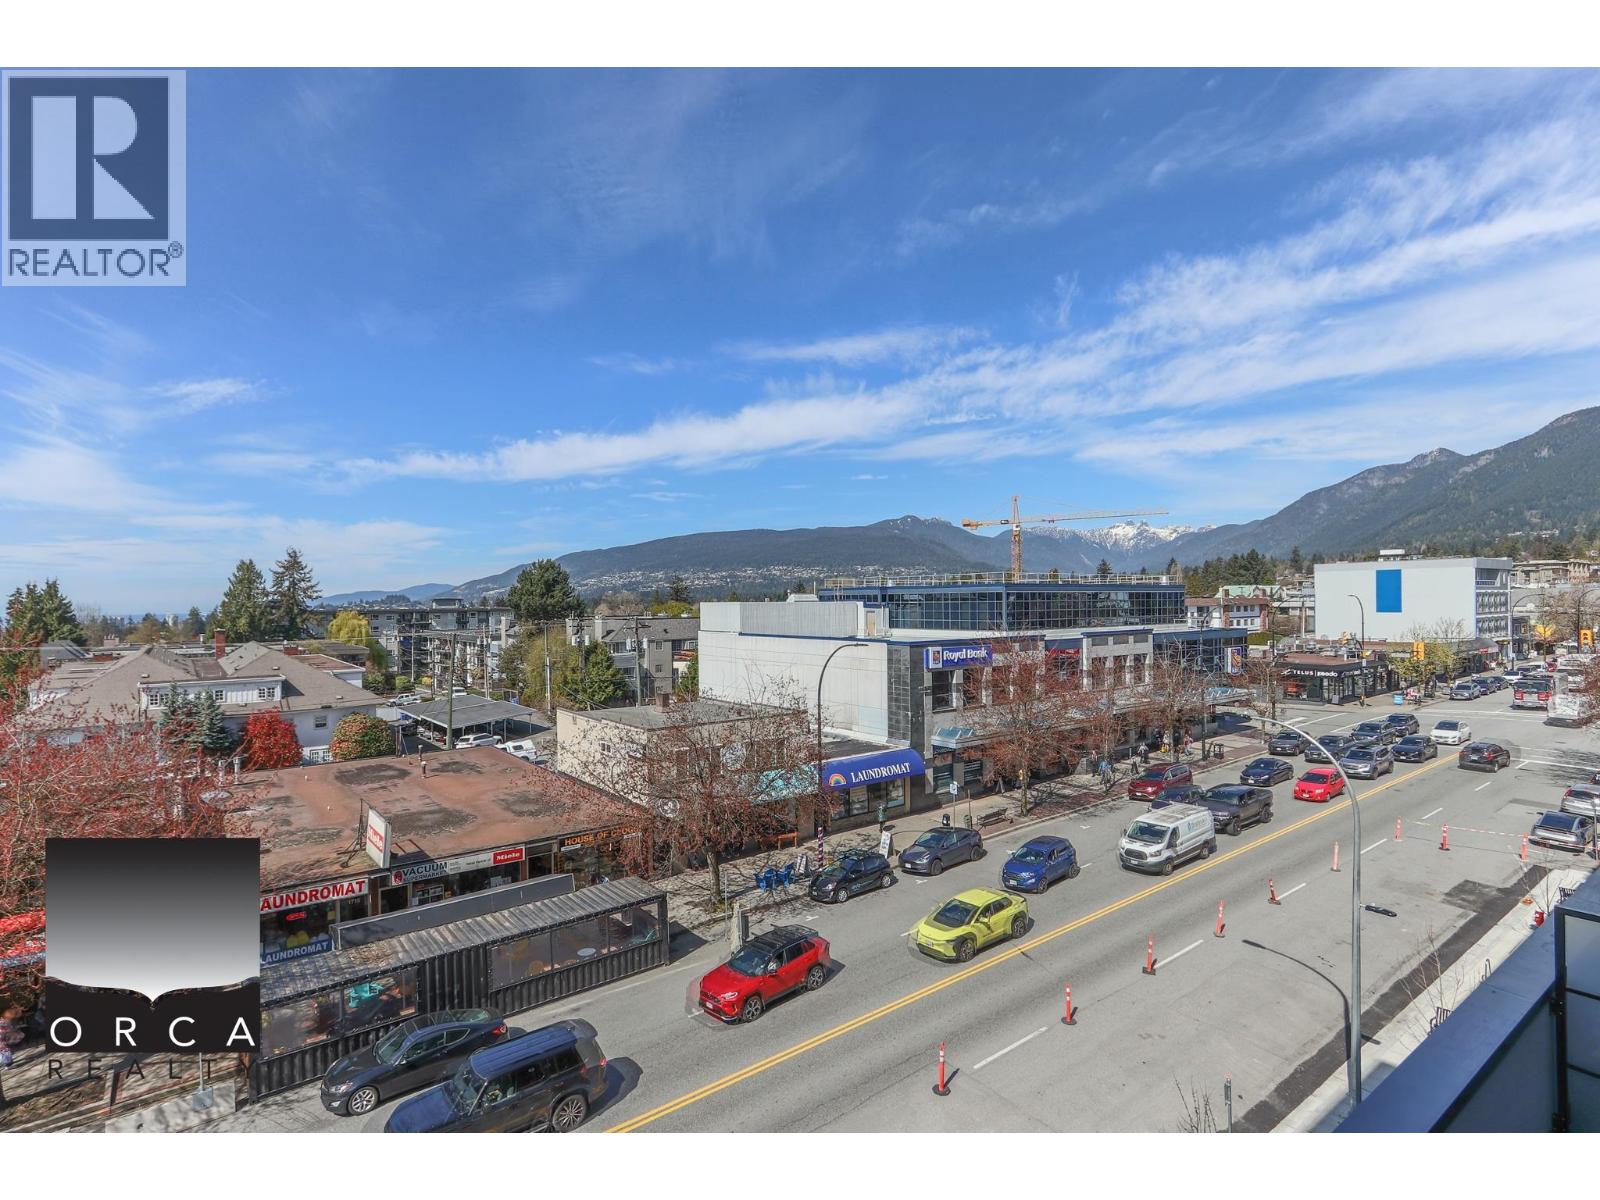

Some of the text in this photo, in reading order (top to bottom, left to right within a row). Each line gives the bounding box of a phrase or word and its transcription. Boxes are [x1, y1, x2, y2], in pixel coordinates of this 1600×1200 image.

[943, 648, 966, 663] Royal
[850, 762, 911, 783] LAUNDROMAT
[564, 834, 594, 845] HOUSE
[598, 831, 609, 839] OF
[496, 852, 521, 861] Miele
[402, 861, 448, 877] VACUUM
[260, 879, 366, 912] AUNDROMAT
